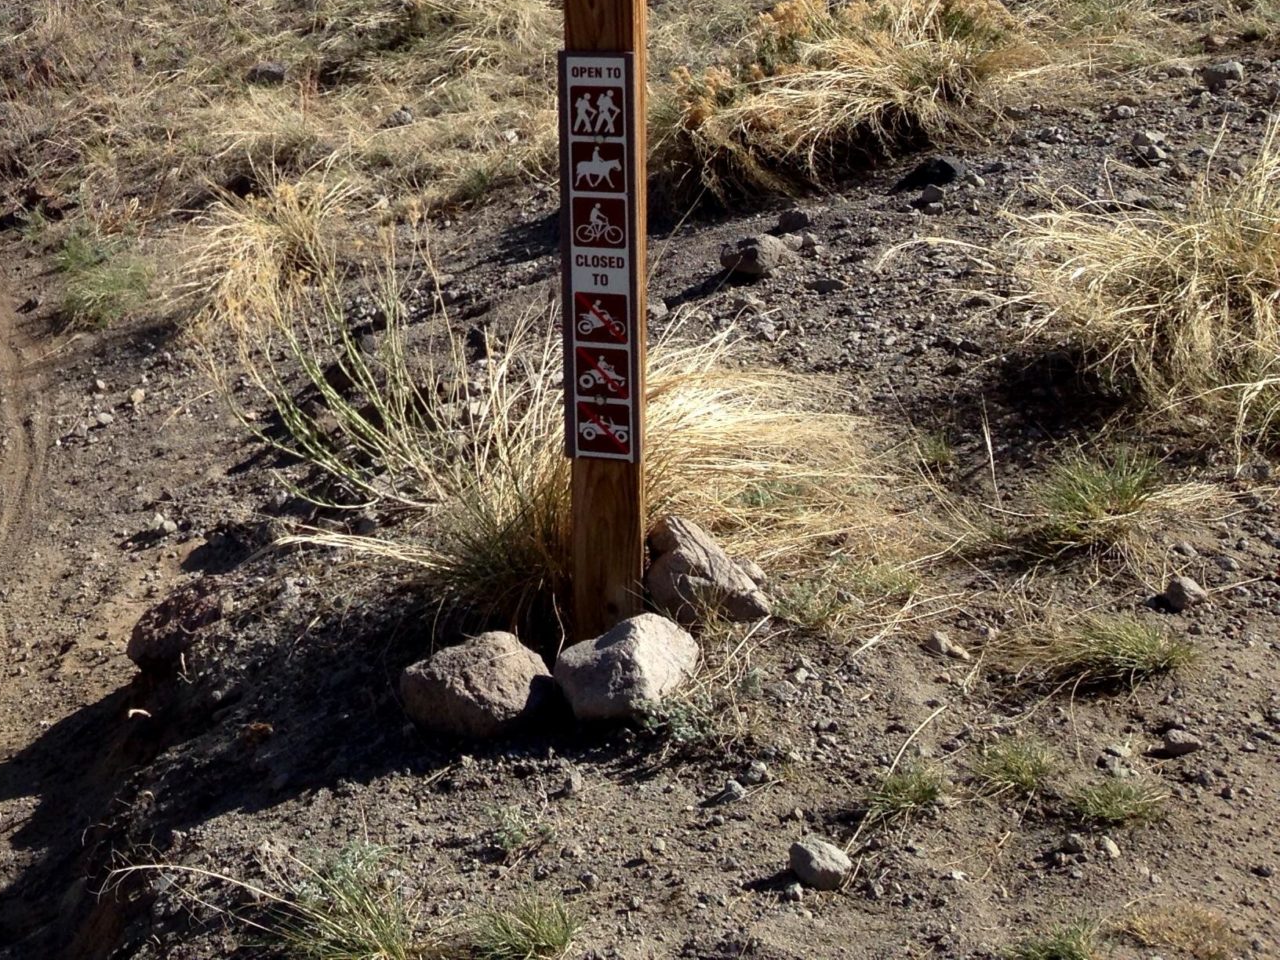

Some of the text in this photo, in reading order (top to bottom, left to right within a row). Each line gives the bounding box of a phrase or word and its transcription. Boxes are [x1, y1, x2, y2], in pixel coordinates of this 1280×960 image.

[571, 66, 622, 79] OPEN TO
[575, 254, 625, 269] CLOSED
[592, 273, 609, 286] TO
